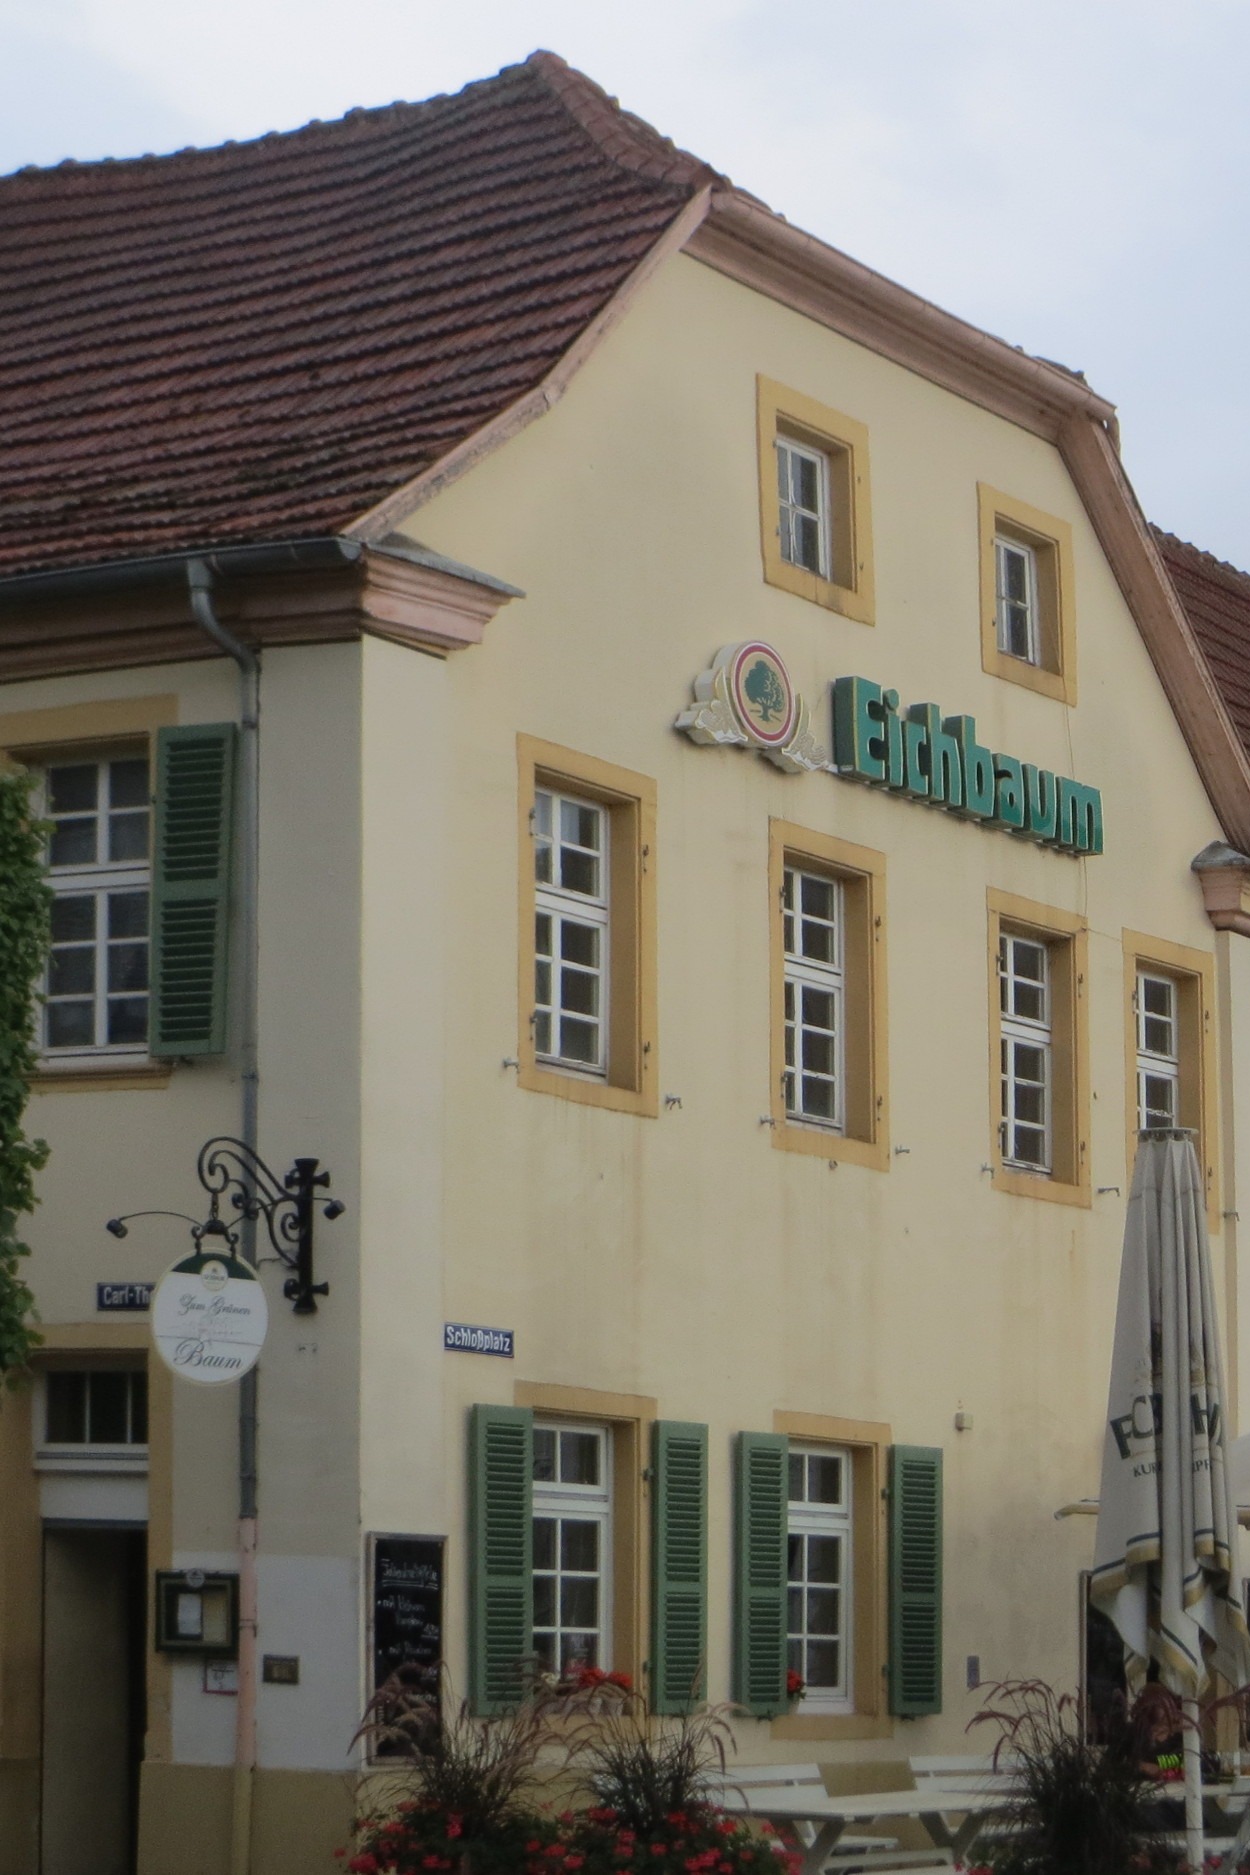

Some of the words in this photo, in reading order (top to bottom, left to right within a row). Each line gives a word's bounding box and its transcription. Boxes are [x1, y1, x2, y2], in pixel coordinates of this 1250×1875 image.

[835, 675, 1104, 855] Eichbaum
[177, 1293, 206, 1316] Zum
[446, 1326, 510, 1352] Schloßplatz
[173, 1338, 242, 1369] Baum
